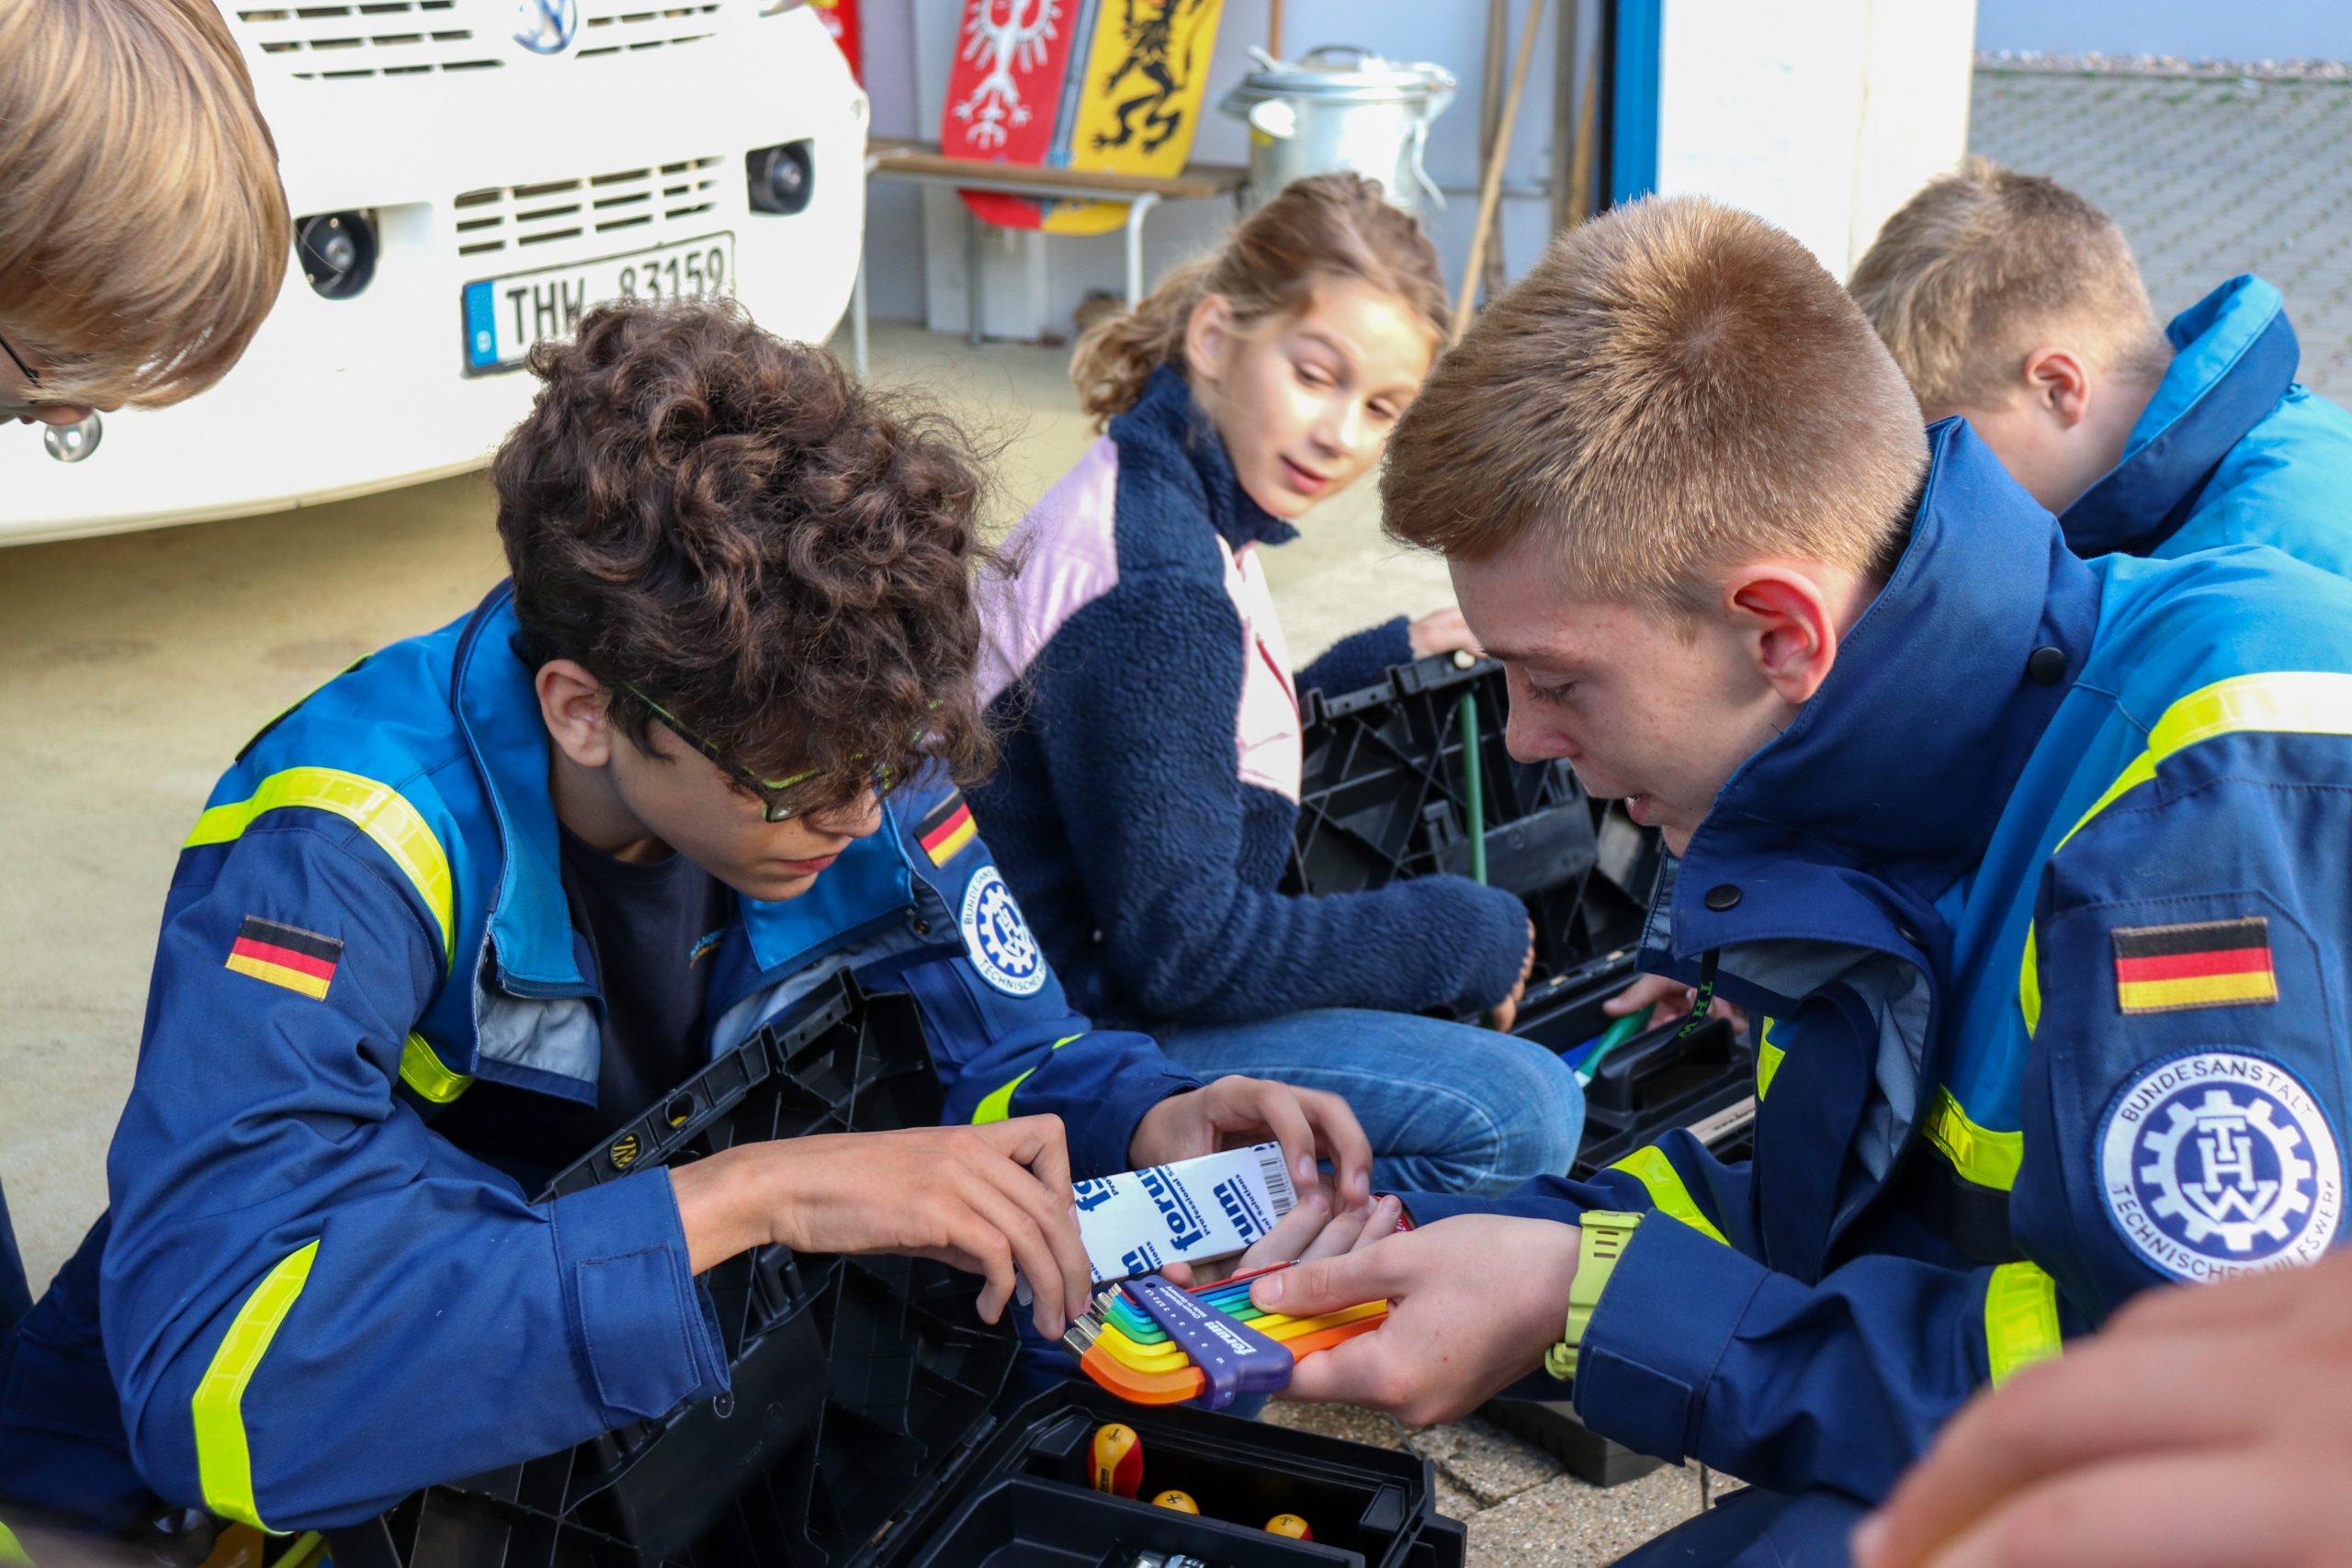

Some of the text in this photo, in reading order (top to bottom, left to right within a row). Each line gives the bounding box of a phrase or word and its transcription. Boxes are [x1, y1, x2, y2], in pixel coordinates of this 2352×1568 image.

[506, 246, 723, 344] THW 83159
[1678, 981, 1713, 1040] THW
[2121, 1060, 2312, 1122] BUNDESANSTALT
[1235, 1174, 1262, 1216] Solutions
[2181, 1115, 2278, 1224] THW
[1135, 1169, 1203, 1251] foru
[1173, 1179, 1211, 1235] Professional
[1204, 1321, 1257, 1355] forum
